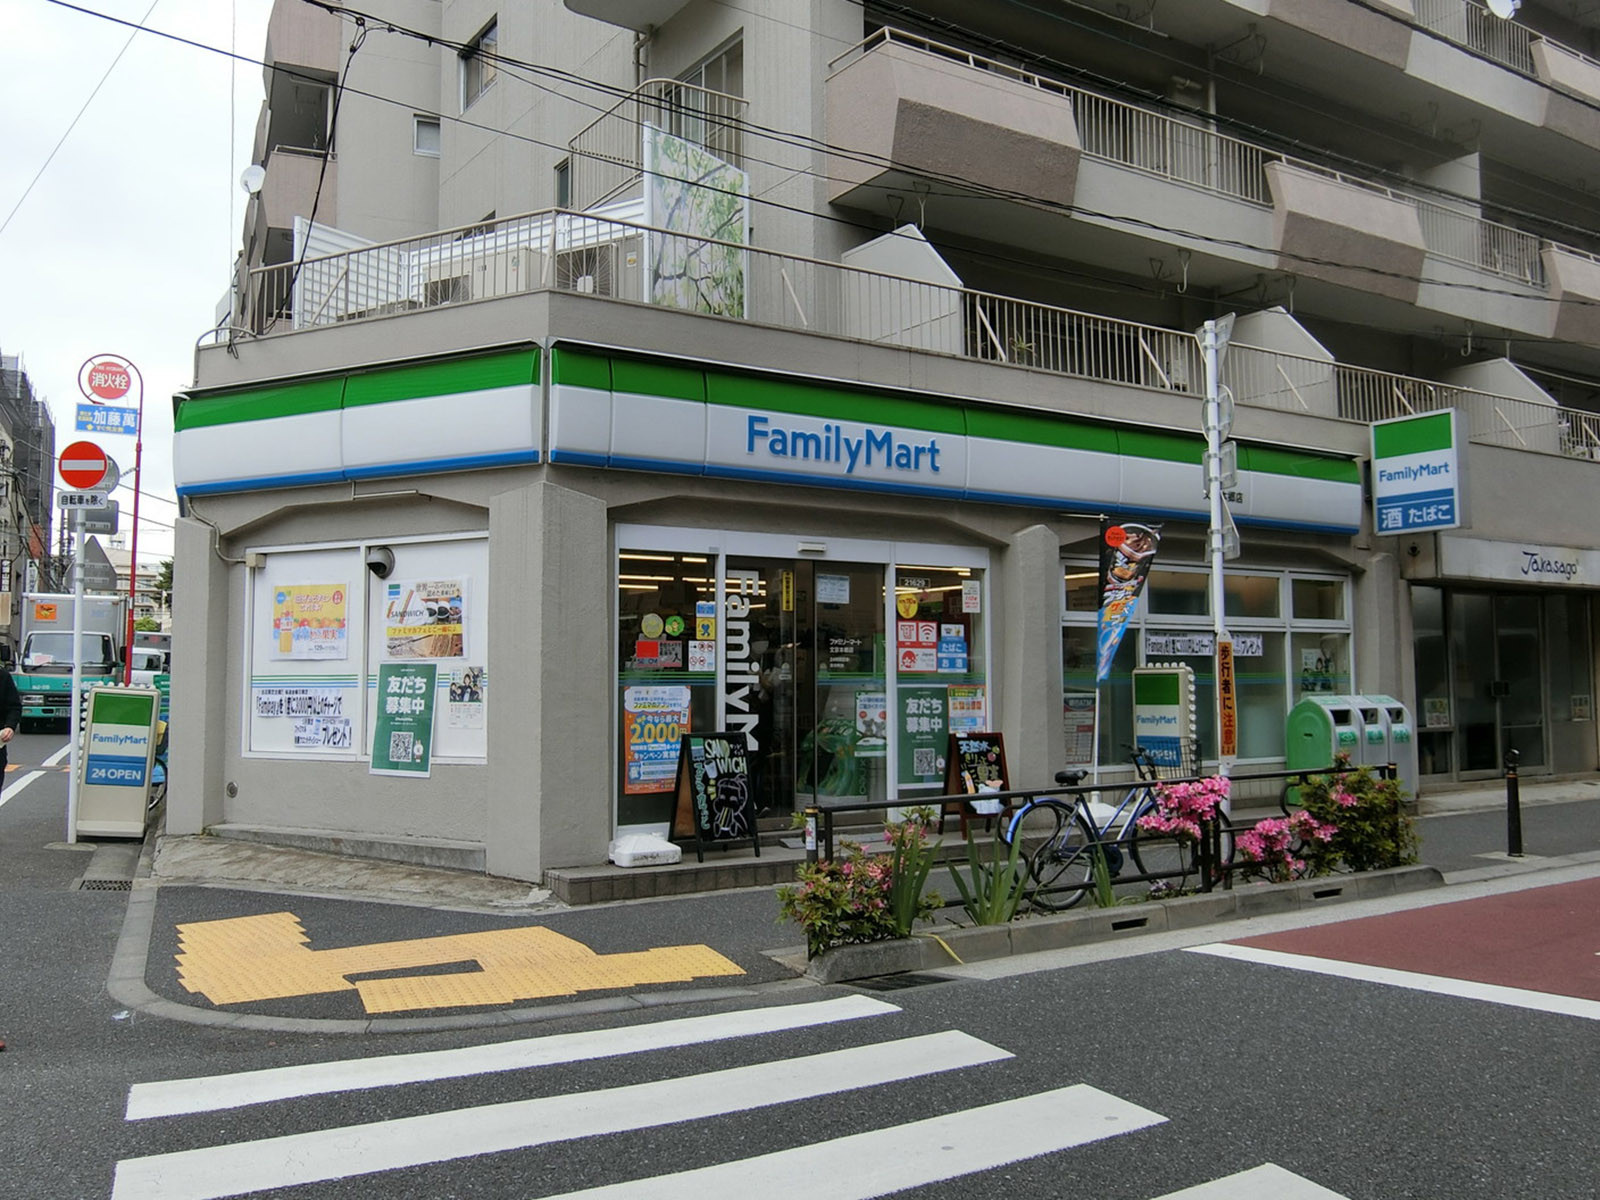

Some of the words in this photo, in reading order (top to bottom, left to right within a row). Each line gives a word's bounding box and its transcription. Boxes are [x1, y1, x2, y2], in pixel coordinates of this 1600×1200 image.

[92, 372, 128, 389] 消火栓
[747, 414, 940, 473] FamilyMart
[1379, 461, 1450, 481] FamilyMart
[61, 494, 103, 505] 自転車を除く
[1381, 507, 1402, 528] 酒
[1408, 504, 1451, 523] たばこ
[391, 610, 424, 618] SANDWICH
[829, 638, 862, 646] ファミリーマート
[942, 643, 963, 652] たばこ
[387, 676, 427, 694] 友だち
[385, 697, 425, 715] 募集中
[906, 697, 943, 714] 友だち
[906, 717, 943, 733] 募集中
[1136, 715, 1177, 726] FamilyMart
[92, 733, 148, 746] FamilyMart
[716, 757, 748, 774] WICH
